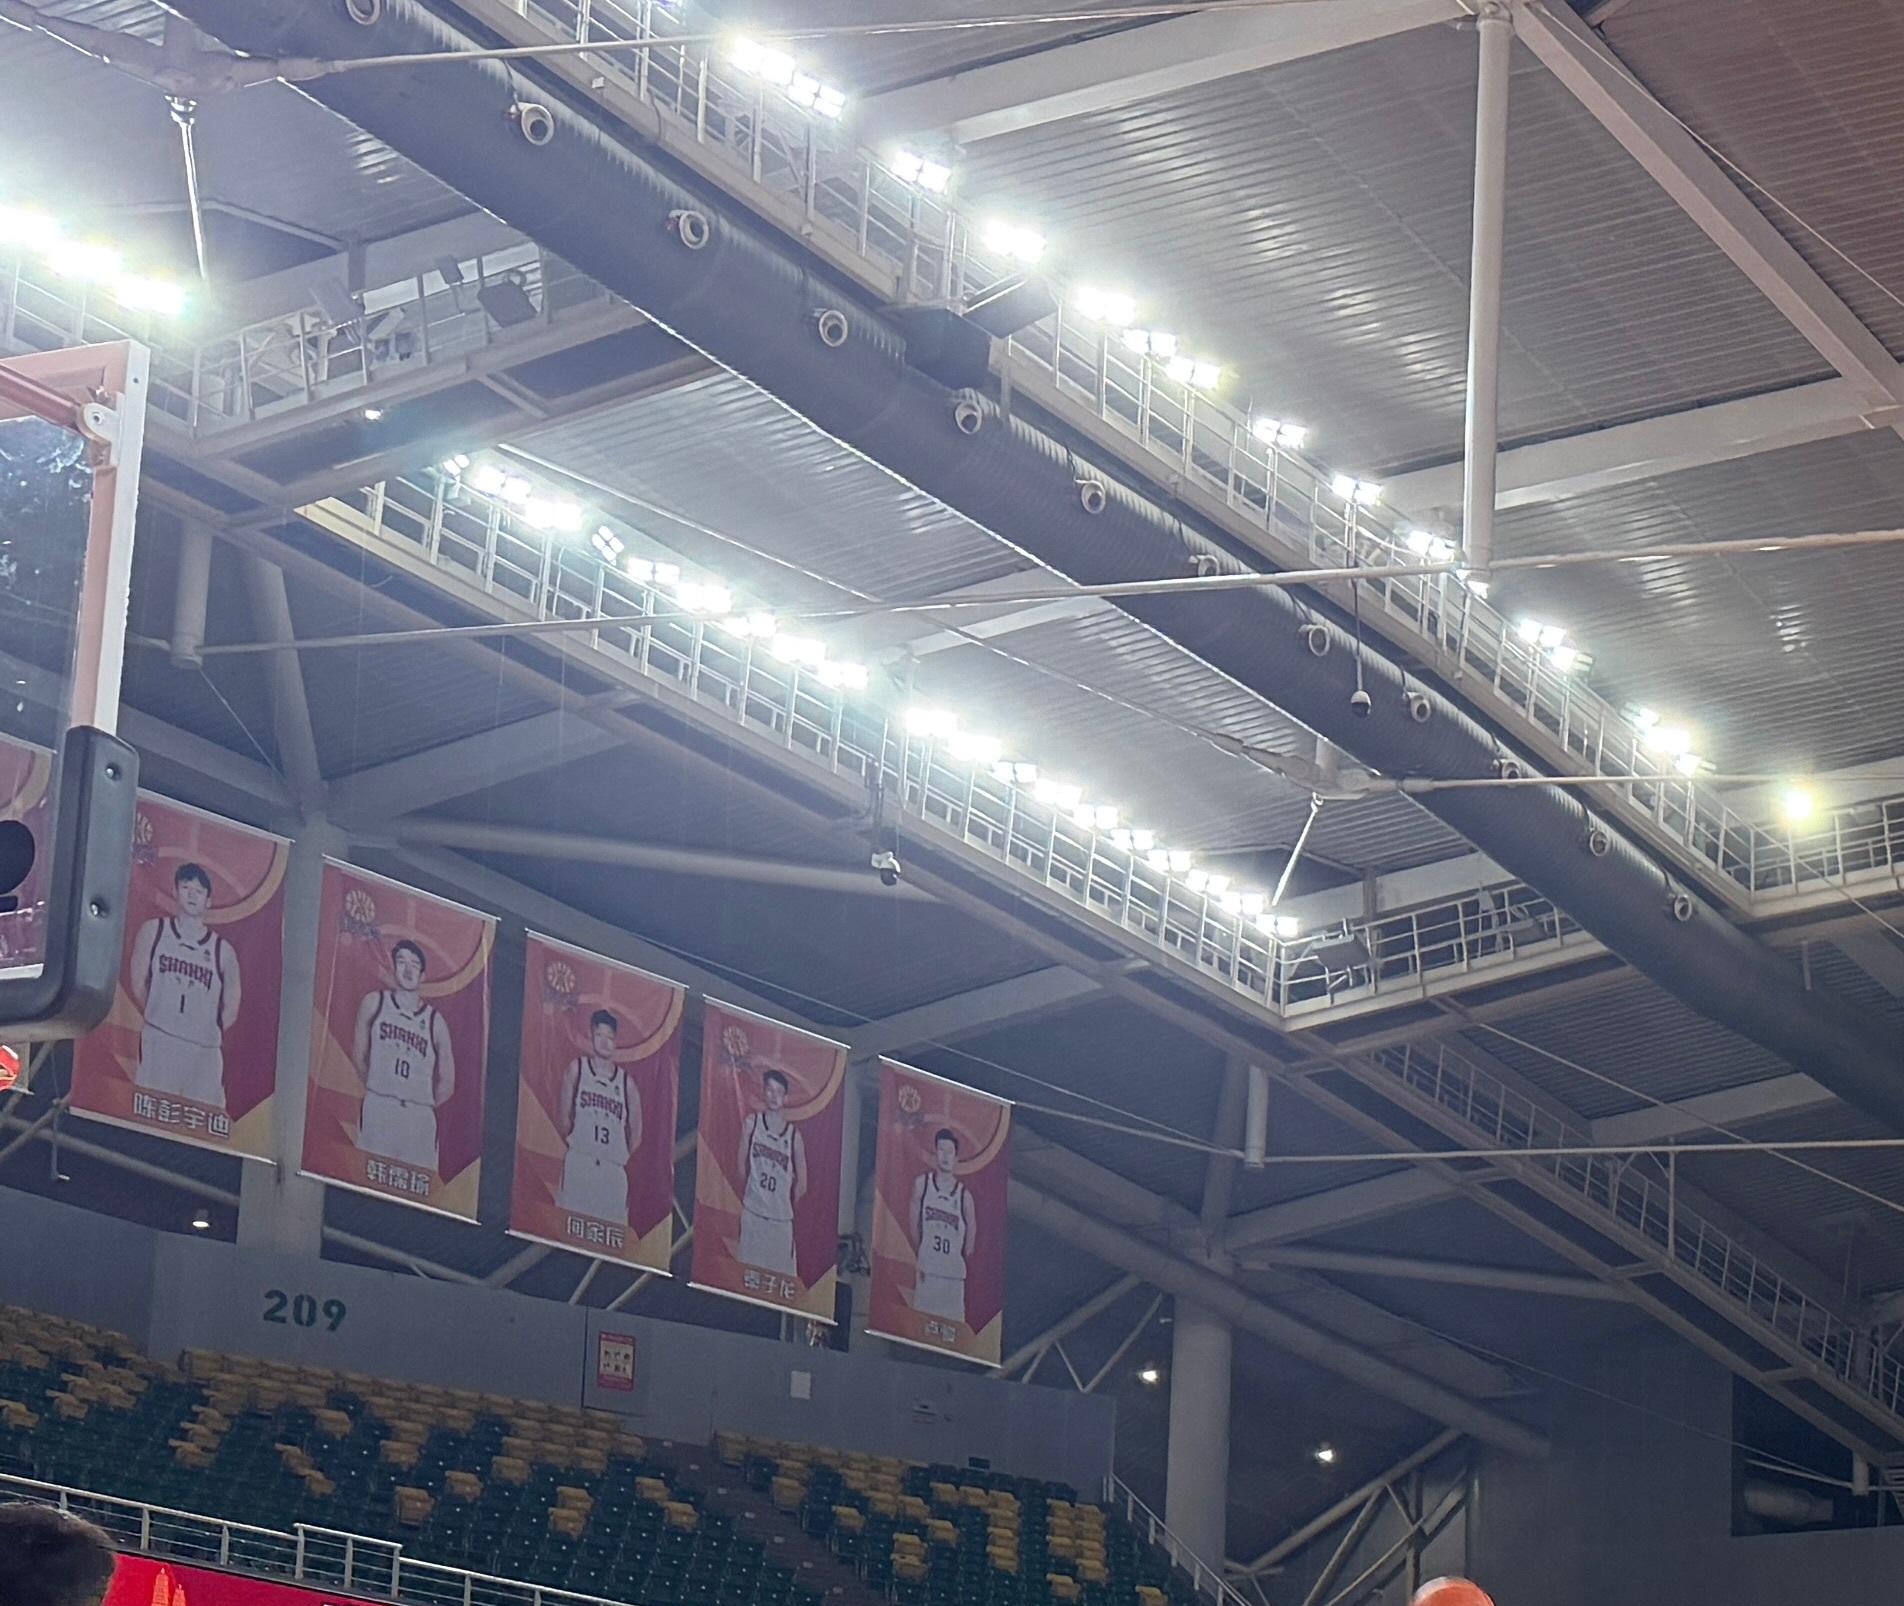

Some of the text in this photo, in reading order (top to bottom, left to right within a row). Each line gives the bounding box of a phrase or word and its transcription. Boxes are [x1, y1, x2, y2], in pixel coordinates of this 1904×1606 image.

[179, 994, 186, 1014] 1
[394, 1057, 410, 1080] 10
[594, 1125, 610, 1145] 13
[760, 1172, 777, 1194] 20
[933, 1236, 951, 1256] 30
[263, 1289, 347, 1332] 209
